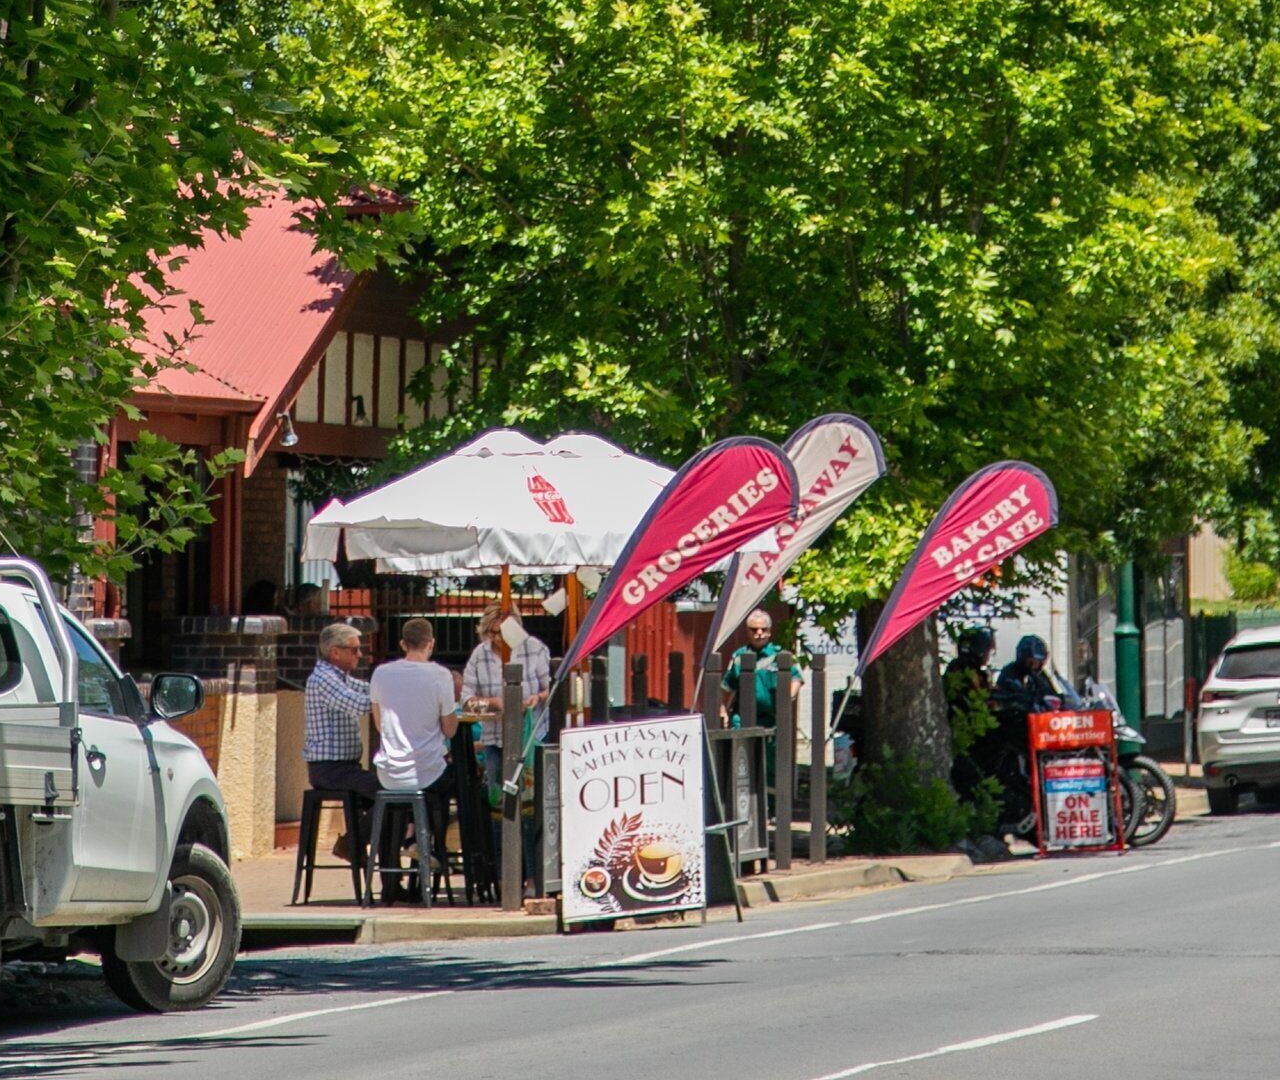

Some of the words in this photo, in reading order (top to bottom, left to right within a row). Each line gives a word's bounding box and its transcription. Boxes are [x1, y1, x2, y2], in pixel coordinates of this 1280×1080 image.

[930, 484, 1031, 568] BAKERY
[622, 467, 780, 606] GROCERIES
[977, 510, 1044, 563] CAFE
[1049, 715, 1094, 731] OPEN
[603, 728, 692, 747] PLEASANT
[1058, 731, 1106, 742] Advertiser
[572, 749, 628, 780] BAKERY
[632, 746, 645, 760] &
[579, 768, 686, 813] OPEN
[1065, 795, 1089, 809] ON
[1057, 810, 1099, 824] SALE
[1055, 825, 1102, 839] HERE
